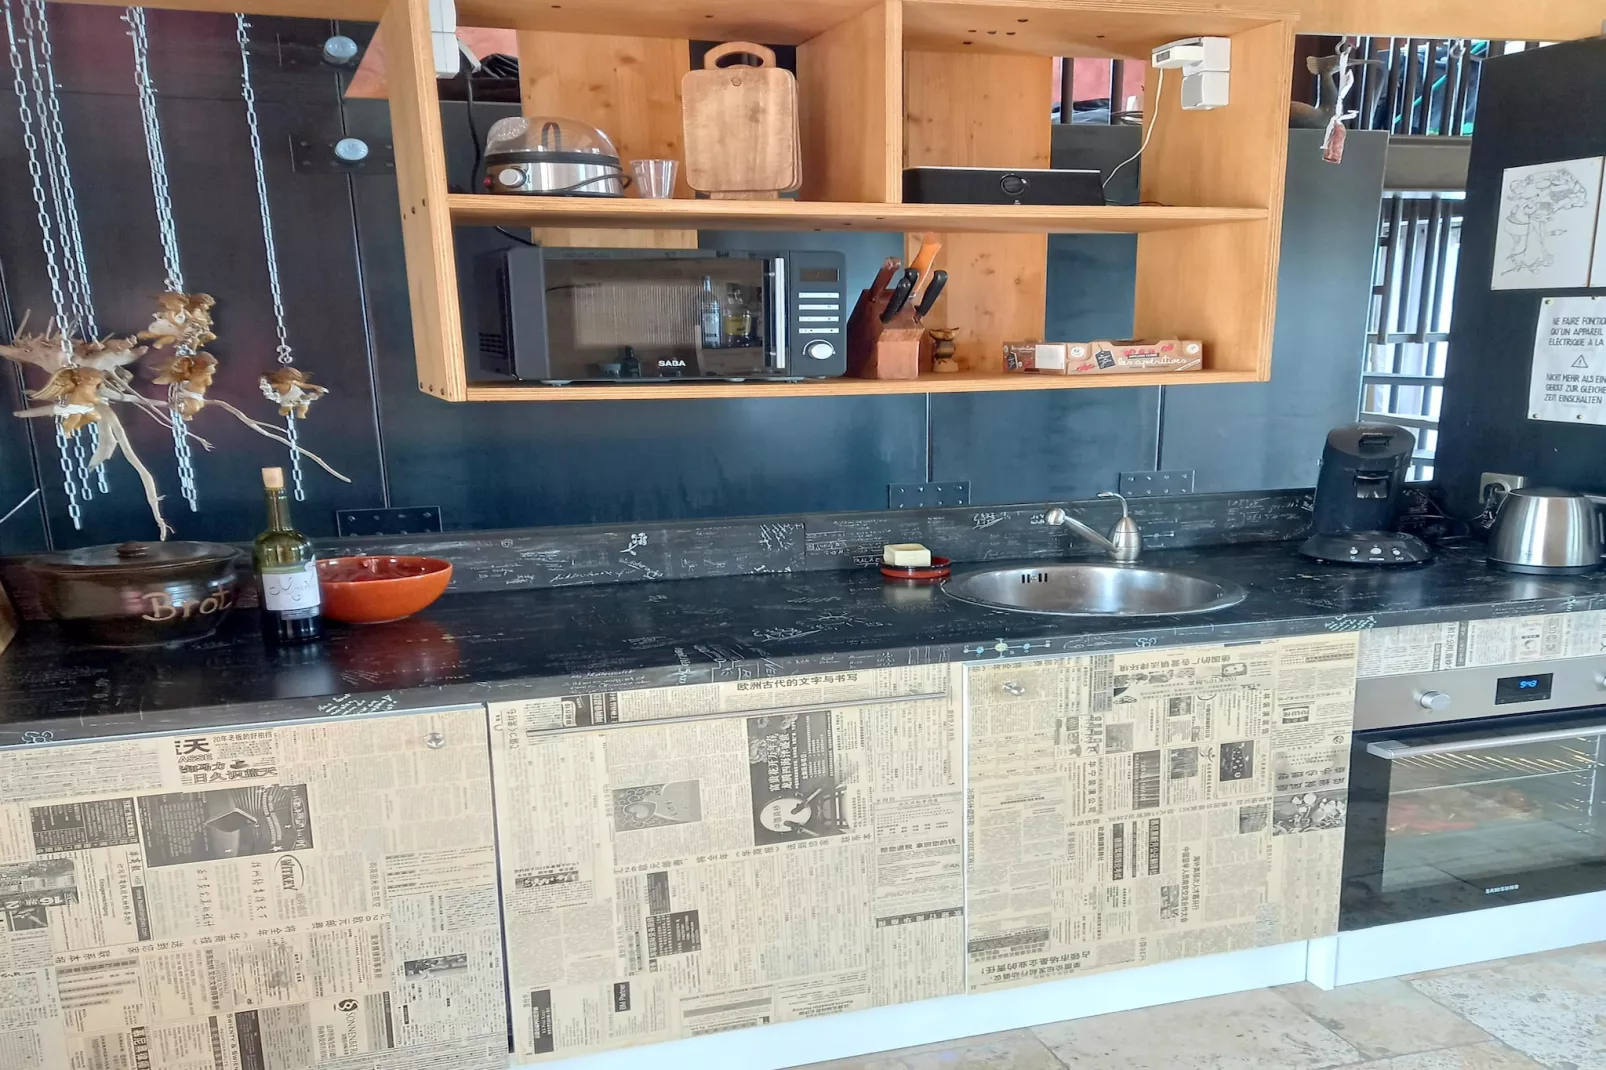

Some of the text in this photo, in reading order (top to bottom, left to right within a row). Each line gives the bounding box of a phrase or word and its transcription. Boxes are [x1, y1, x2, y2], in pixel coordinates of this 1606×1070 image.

[1562, 316, 1580, 325] FAIRE
[1573, 327, 1604, 336] APPAREIL
[1595, 338, 1604, 346] LA
[657, 359, 687, 367] SABA
[1546, 373, 1562, 381] NICHT
[1562, 374, 1580, 382] MEHR
[1581, 374, 1594, 383] ALS
[1565, 384, 1579, 392] ZUR
[1544, 393, 1603, 404] ZEIT EINSCHALTEN
[141, 585, 232, 622] Brot
[736, 673, 858, 691] 欧洲古代的文字与书写
[281, 858, 298, 891] WITKEY
[1485, 884, 1519, 894] SAMSUNG
